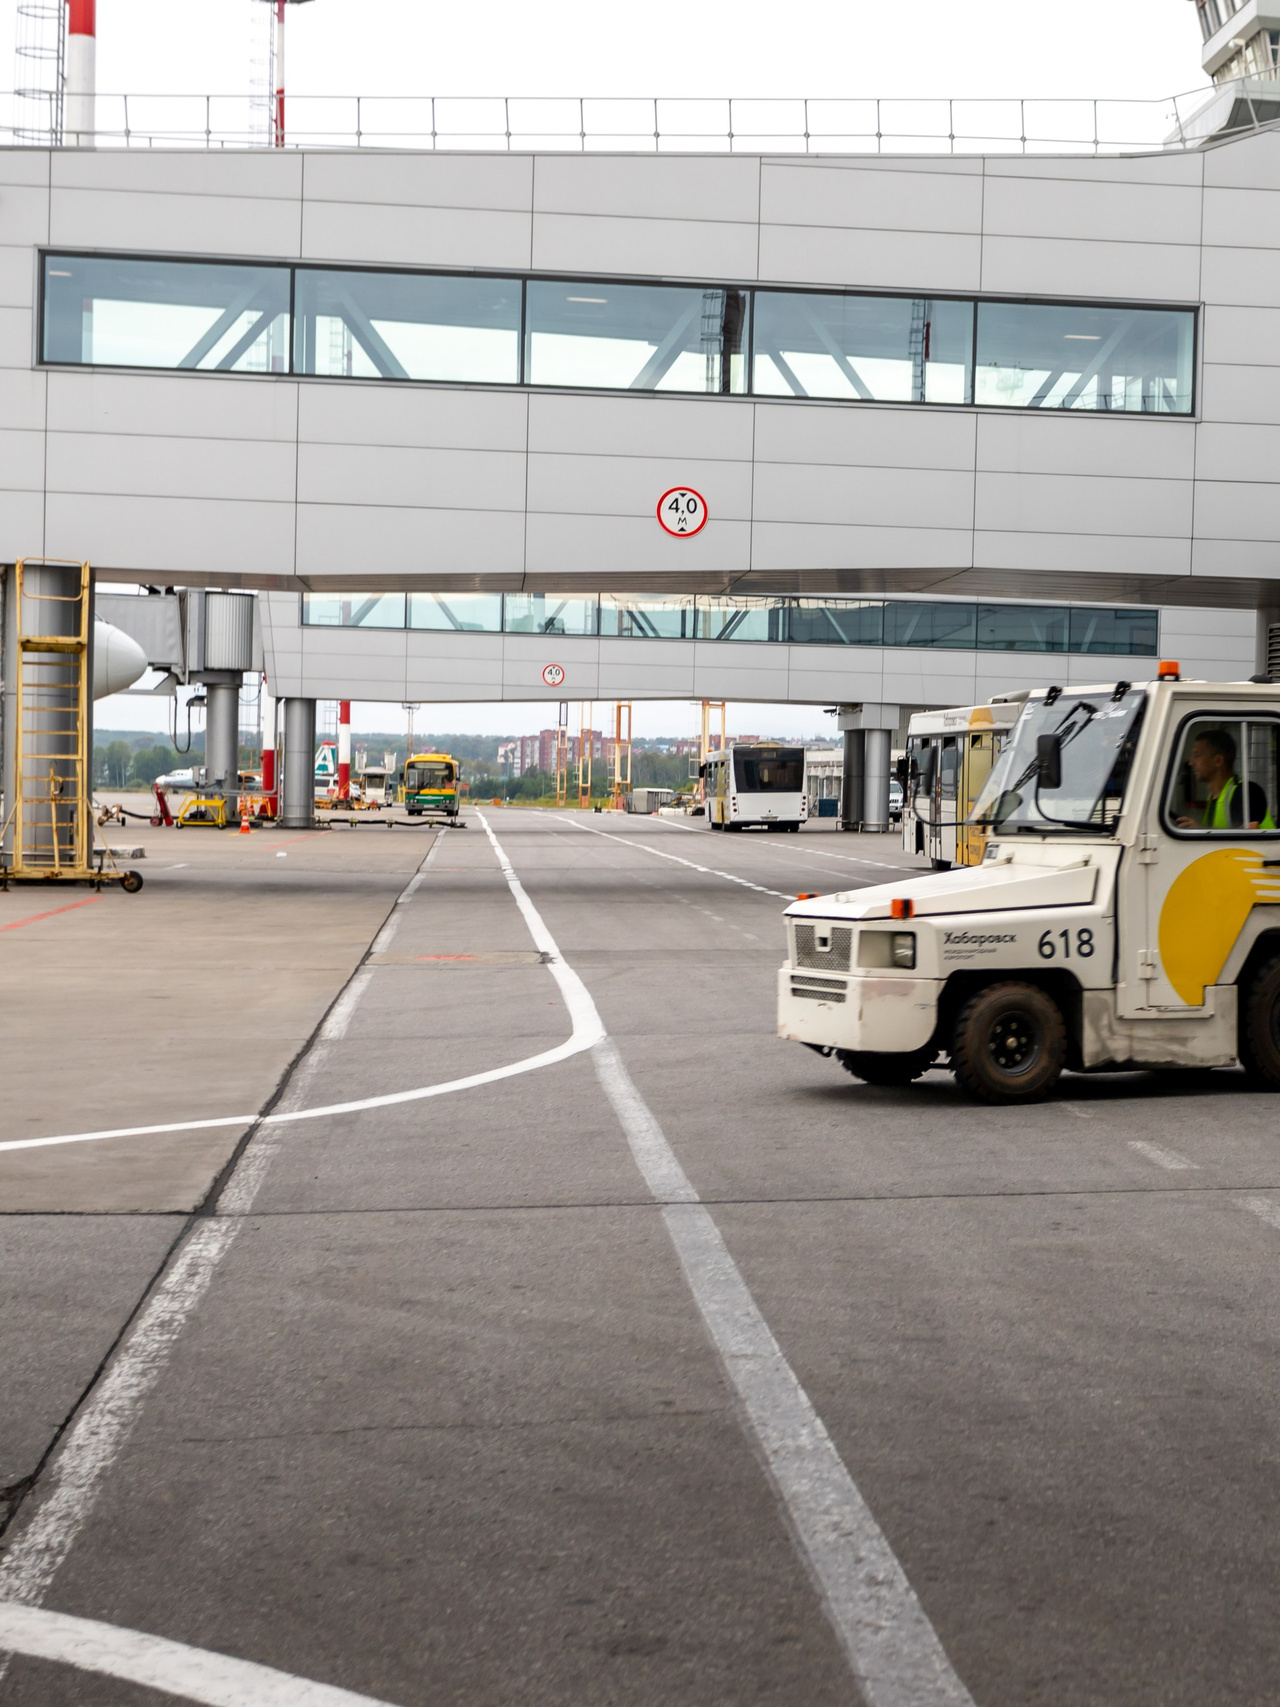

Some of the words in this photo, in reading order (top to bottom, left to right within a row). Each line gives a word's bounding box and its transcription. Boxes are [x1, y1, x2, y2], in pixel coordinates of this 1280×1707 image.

[668, 498, 697, 516] 4,0
[944, 931, 1017, 947] Хабаровск
[1038, 928, 1095, 959] 618
